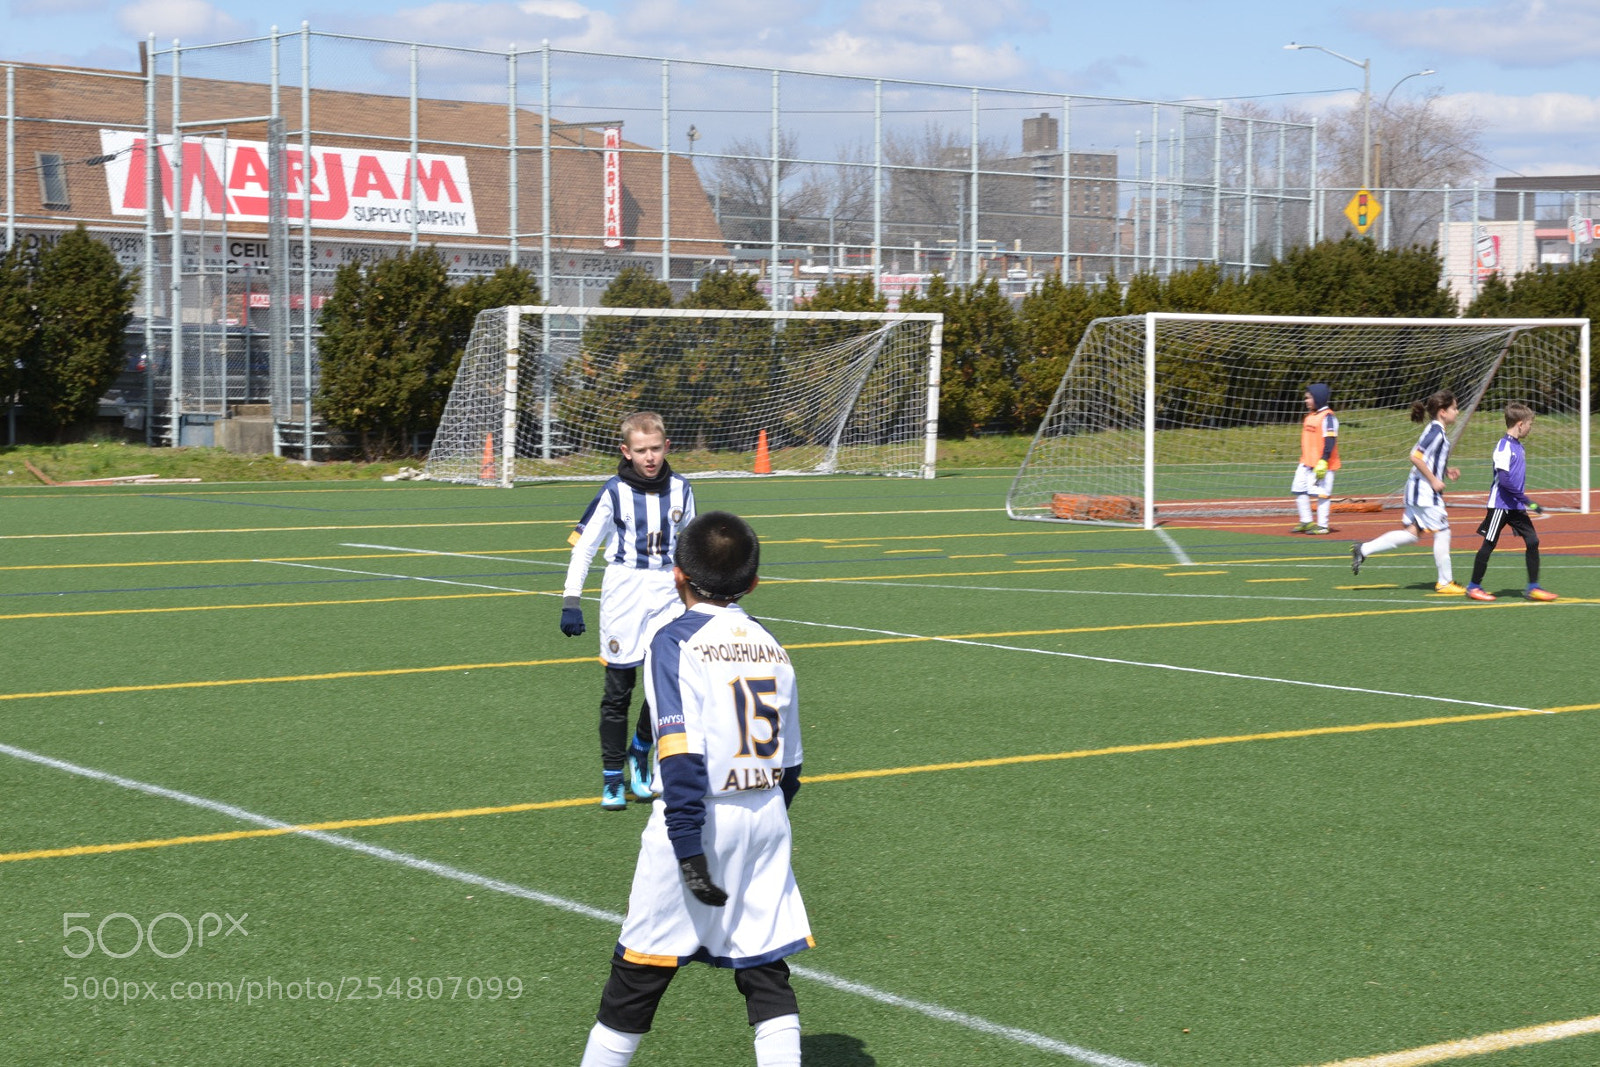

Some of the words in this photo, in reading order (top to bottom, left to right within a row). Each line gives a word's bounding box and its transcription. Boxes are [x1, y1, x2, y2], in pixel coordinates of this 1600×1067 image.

[122, 138, 464, 220] MARJAM
[354, 206, 402, 223] SUPPLY
[606, 134, 617, 241] MARJAM
[647, 530, 663, 556] 11
[728, 675, 780, 759] 15
